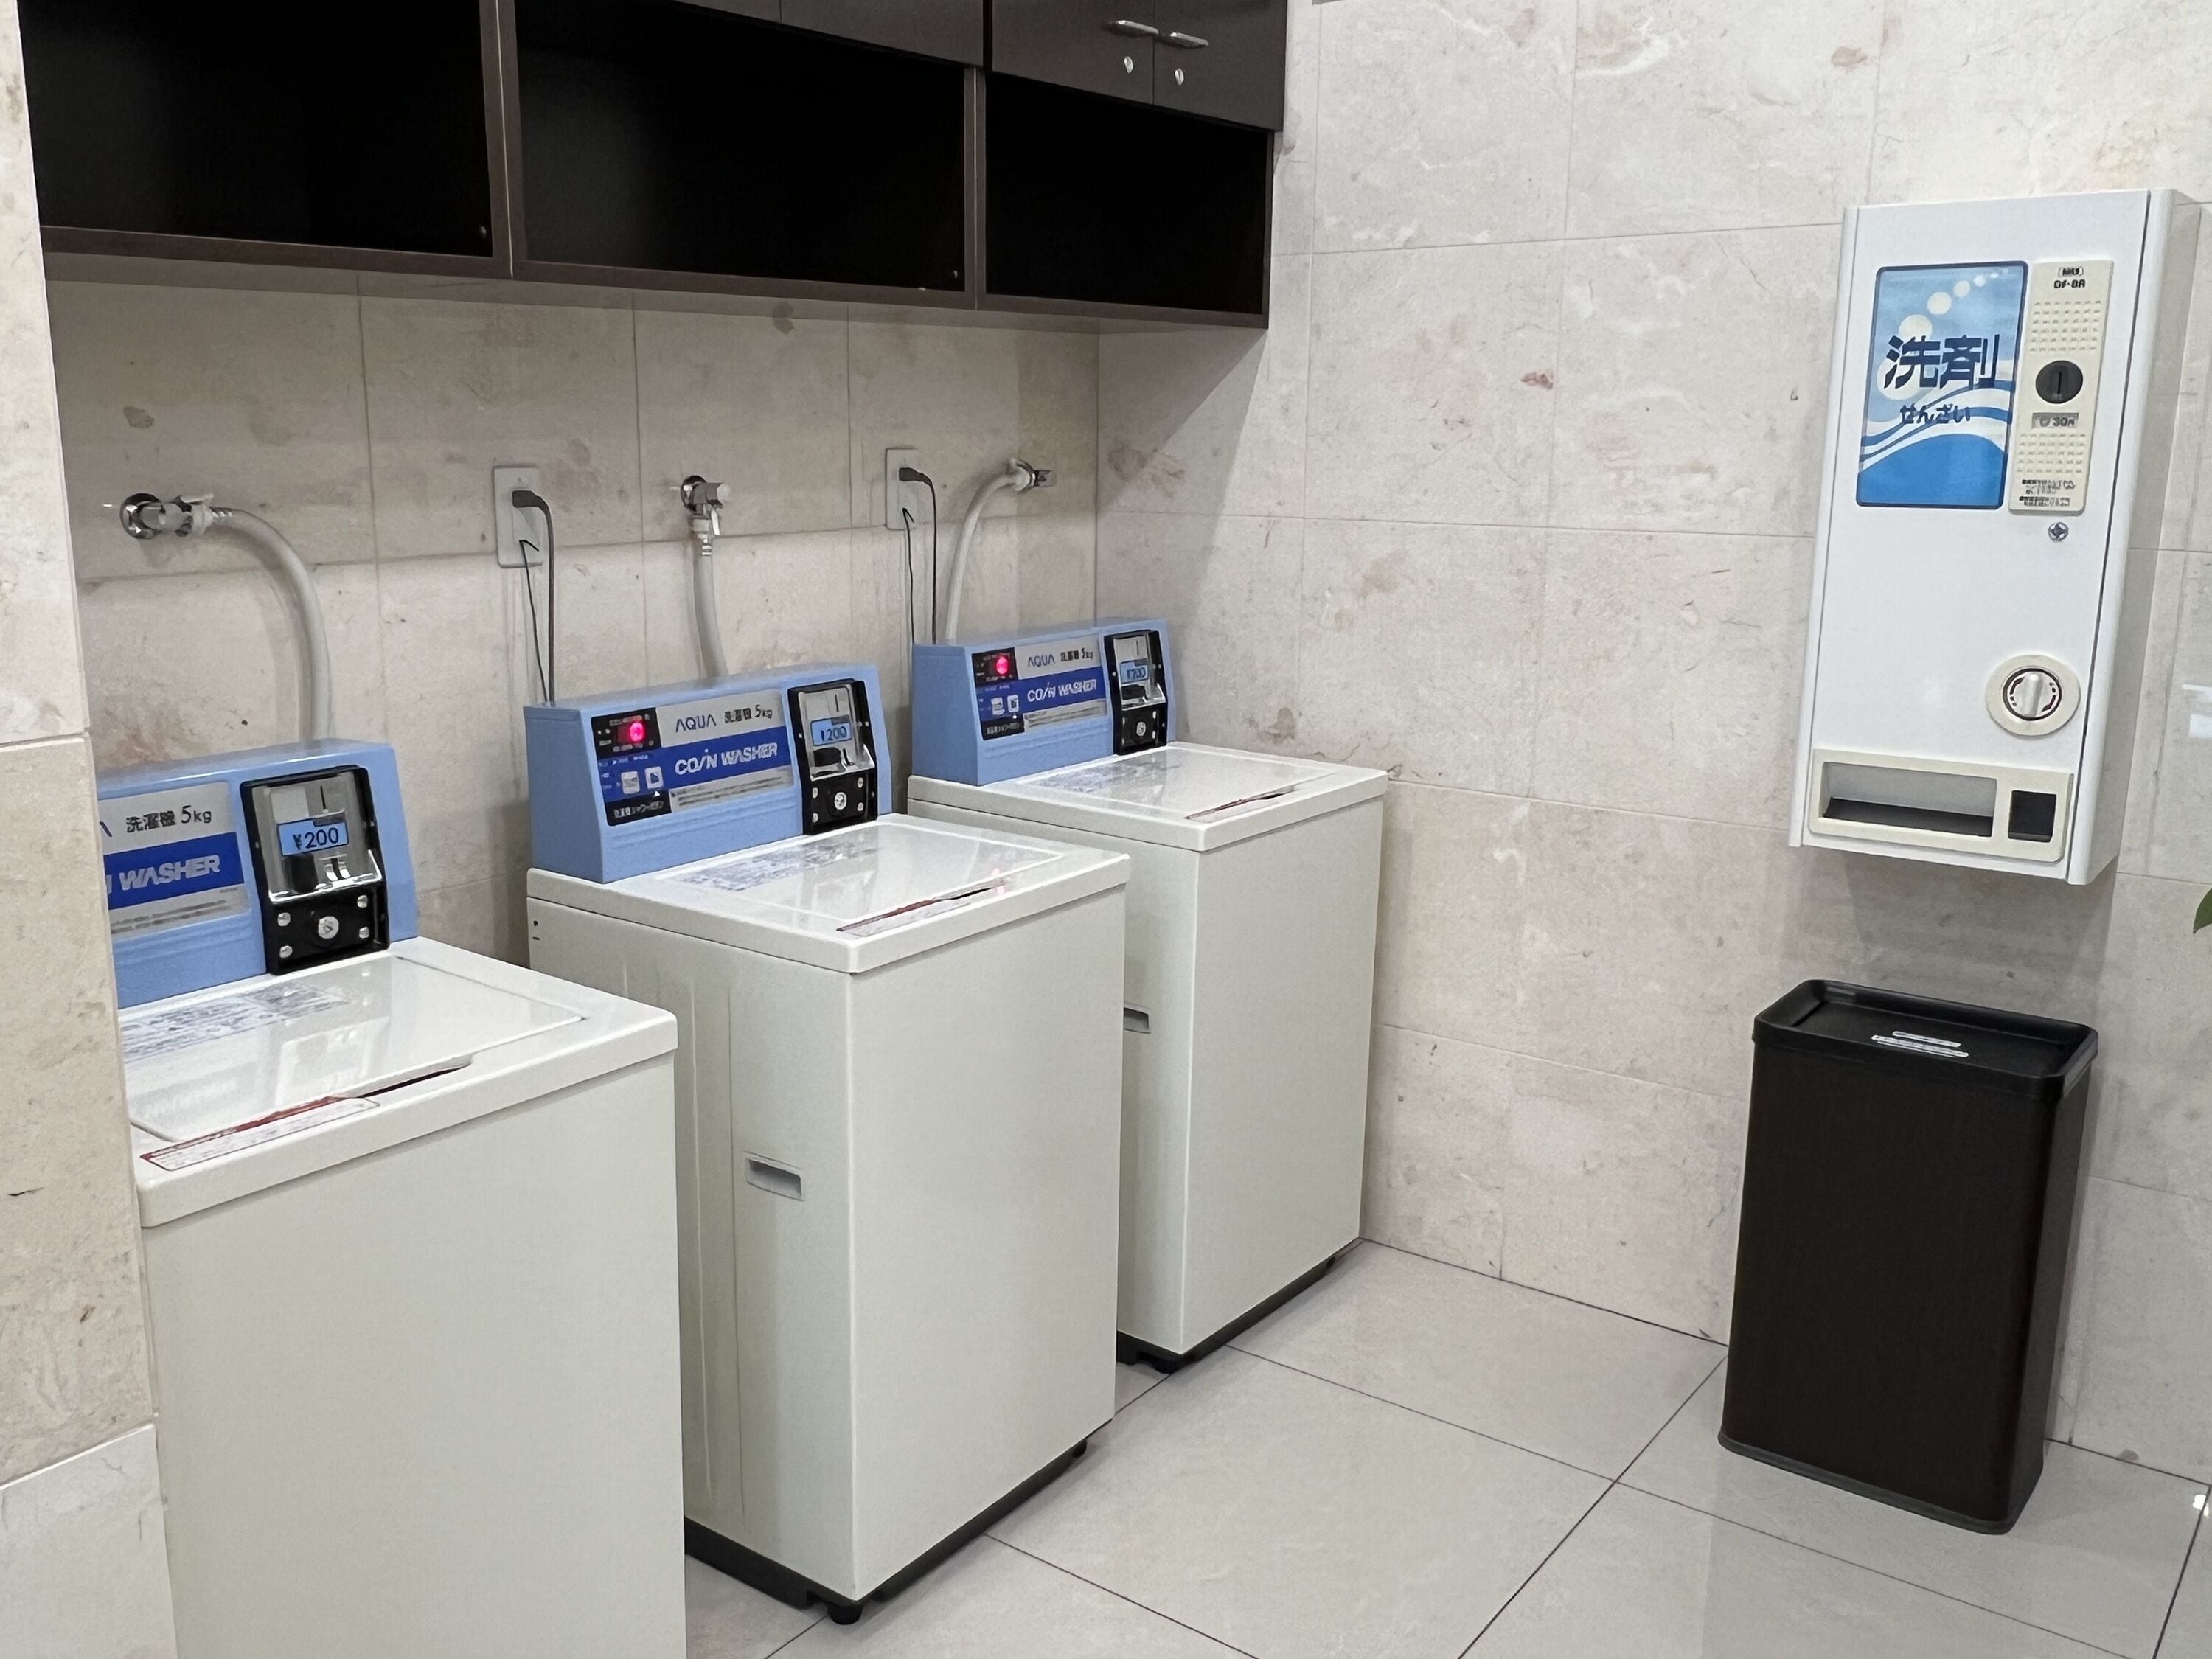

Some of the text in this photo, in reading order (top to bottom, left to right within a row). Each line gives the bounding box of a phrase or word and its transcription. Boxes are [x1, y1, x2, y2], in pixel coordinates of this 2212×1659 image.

[1883, 333, 2000, 390] 洗剤
[1899, 403, 1972, 425] せんざい
[1027, 653, 1056, 667] AQUA
[675, 714, 717, 733] AQUA
[720, 742, 779, 767] WASHER
[181, 804, 212, 824] 5kg
[292, 827, 339, 850] ¥200
[119, 855, 221, 891] WASHER
